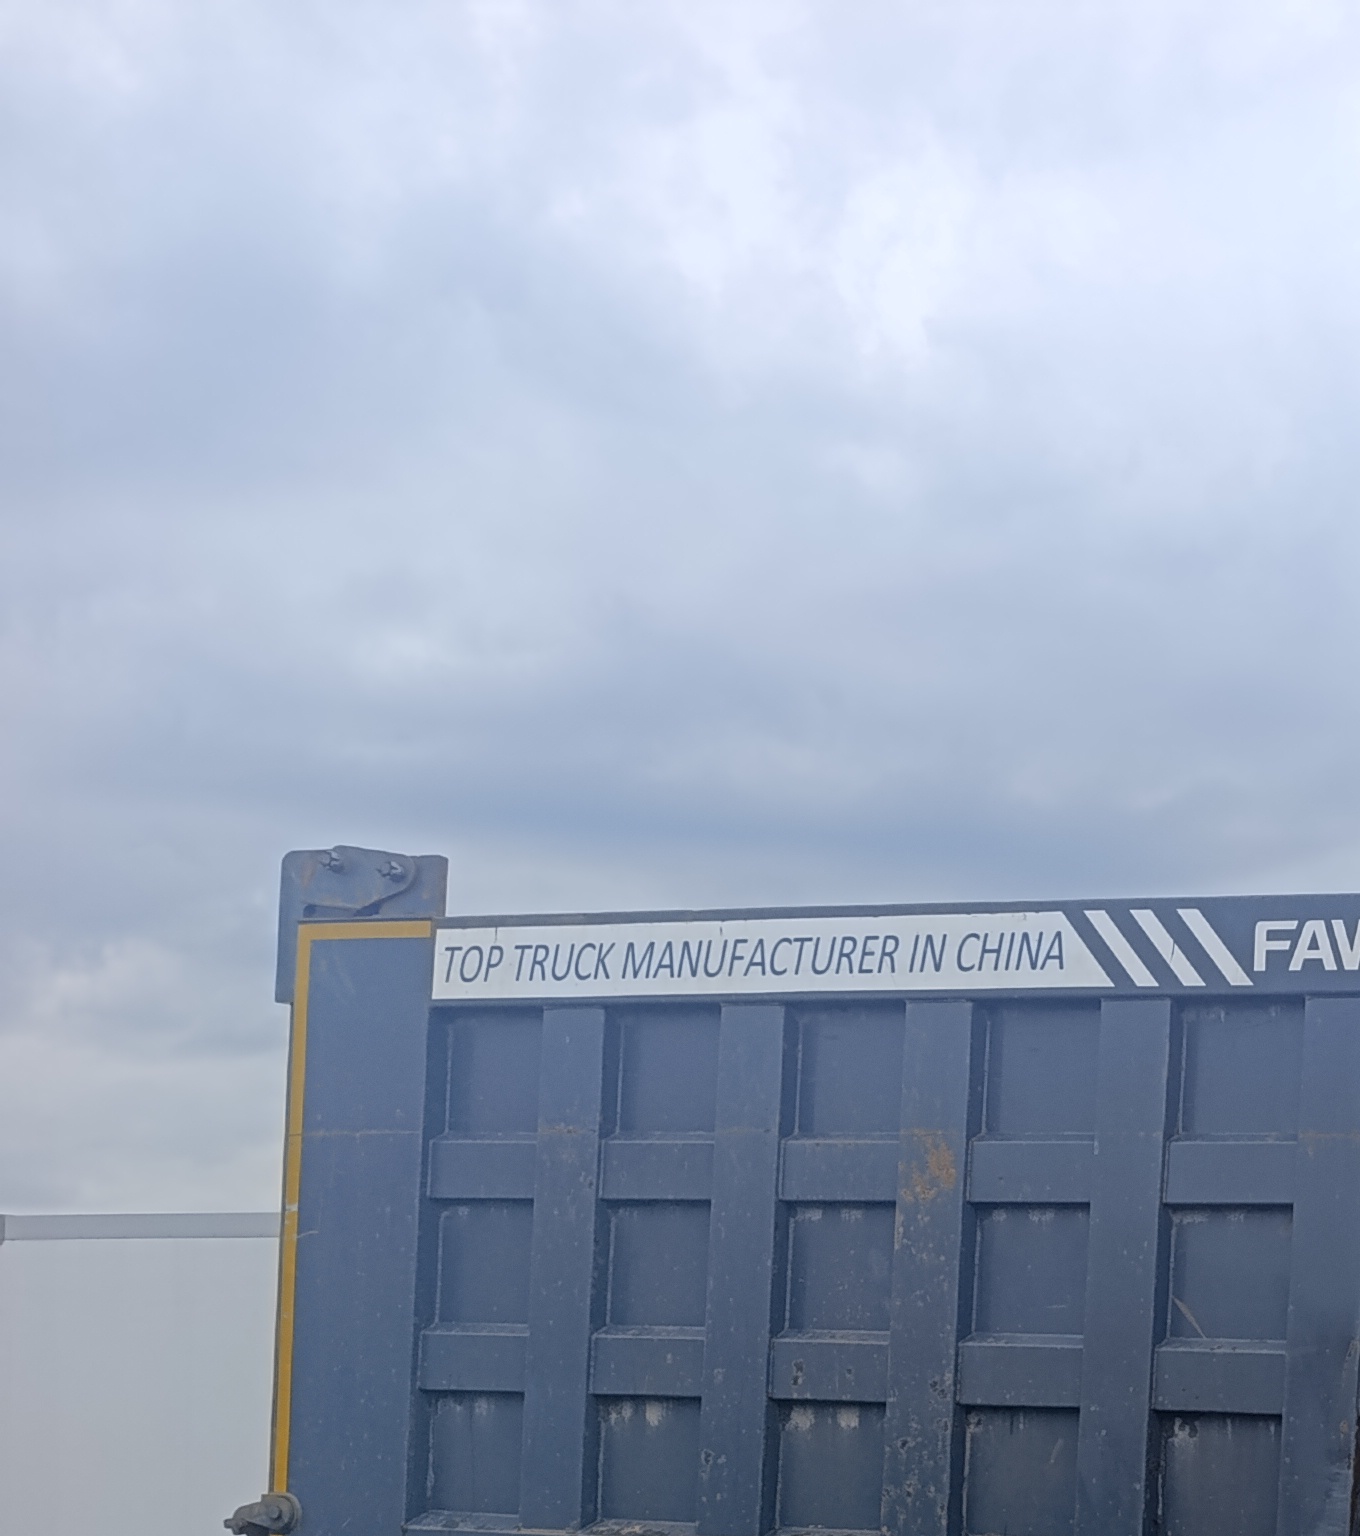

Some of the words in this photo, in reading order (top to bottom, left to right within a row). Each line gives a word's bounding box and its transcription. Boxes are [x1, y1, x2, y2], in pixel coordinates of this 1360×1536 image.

[443, 945, 506, 984] TOP
[514, 941, 614, 982] TRUCK
[621, 932, 898, 980] MANUFACTURER
[909, 931, 949, 973] IN
[955, 929, 1065, 973] CHINA
